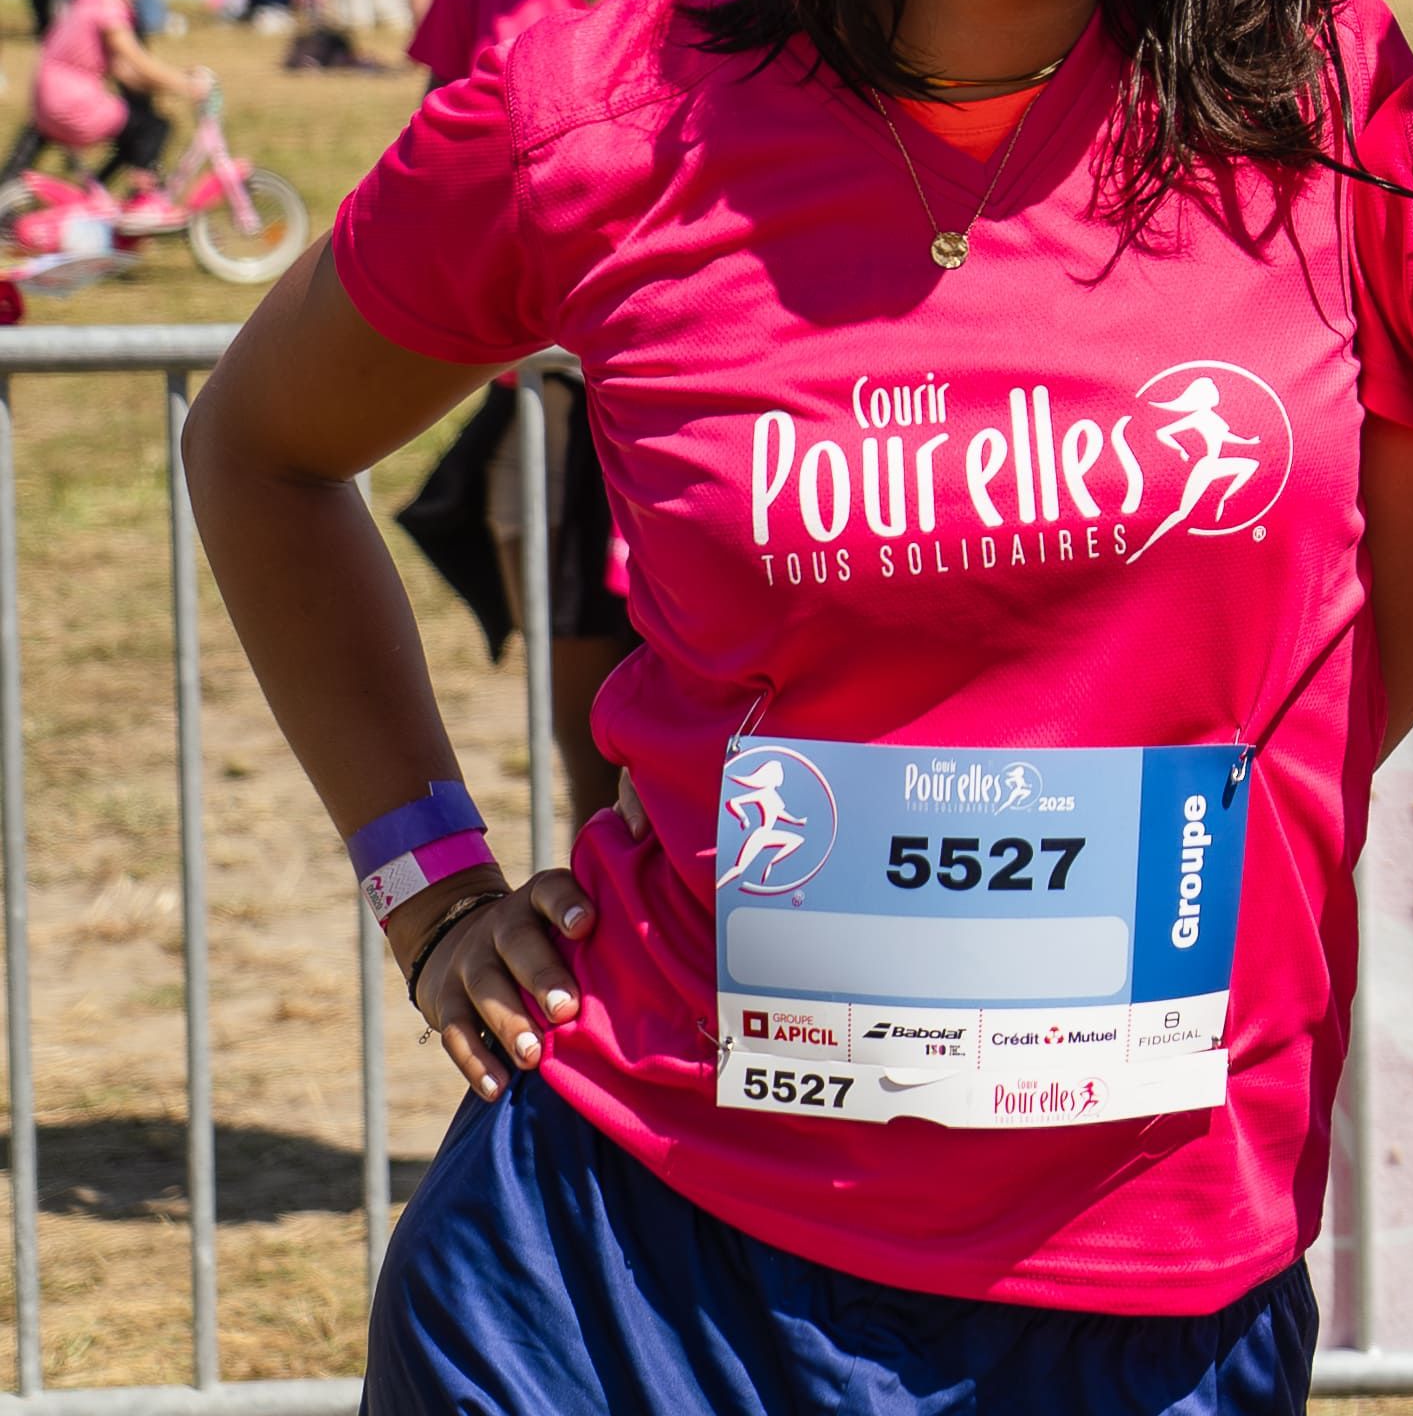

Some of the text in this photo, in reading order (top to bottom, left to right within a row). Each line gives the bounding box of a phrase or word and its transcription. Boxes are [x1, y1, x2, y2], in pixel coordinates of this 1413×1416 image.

[853, 372, 950, 429] Courir
[752, 385, 1144, 547] Pour elles
[762, 523, 1129, 587] TOUS SOLIDAIRES
[905, 763, 1002, 803] Pour elles
[1038, 796, 1076, 812] 2025
[886, 835, 1087, 892] 5527
[1171, 795, 1213, 950] Groupe
[772, 1012, 814, 1025] GROUPE
[774, 1025, 838, 1046] APICIL
[991, 1029, 1117, 1047] Crédit Mutuel
[1138, 1029, 1202, 1049] FIDUCIAL
[743, 1067, 855, 1109] 5527
[994, 1082, 1075, 1114] Pour elles
